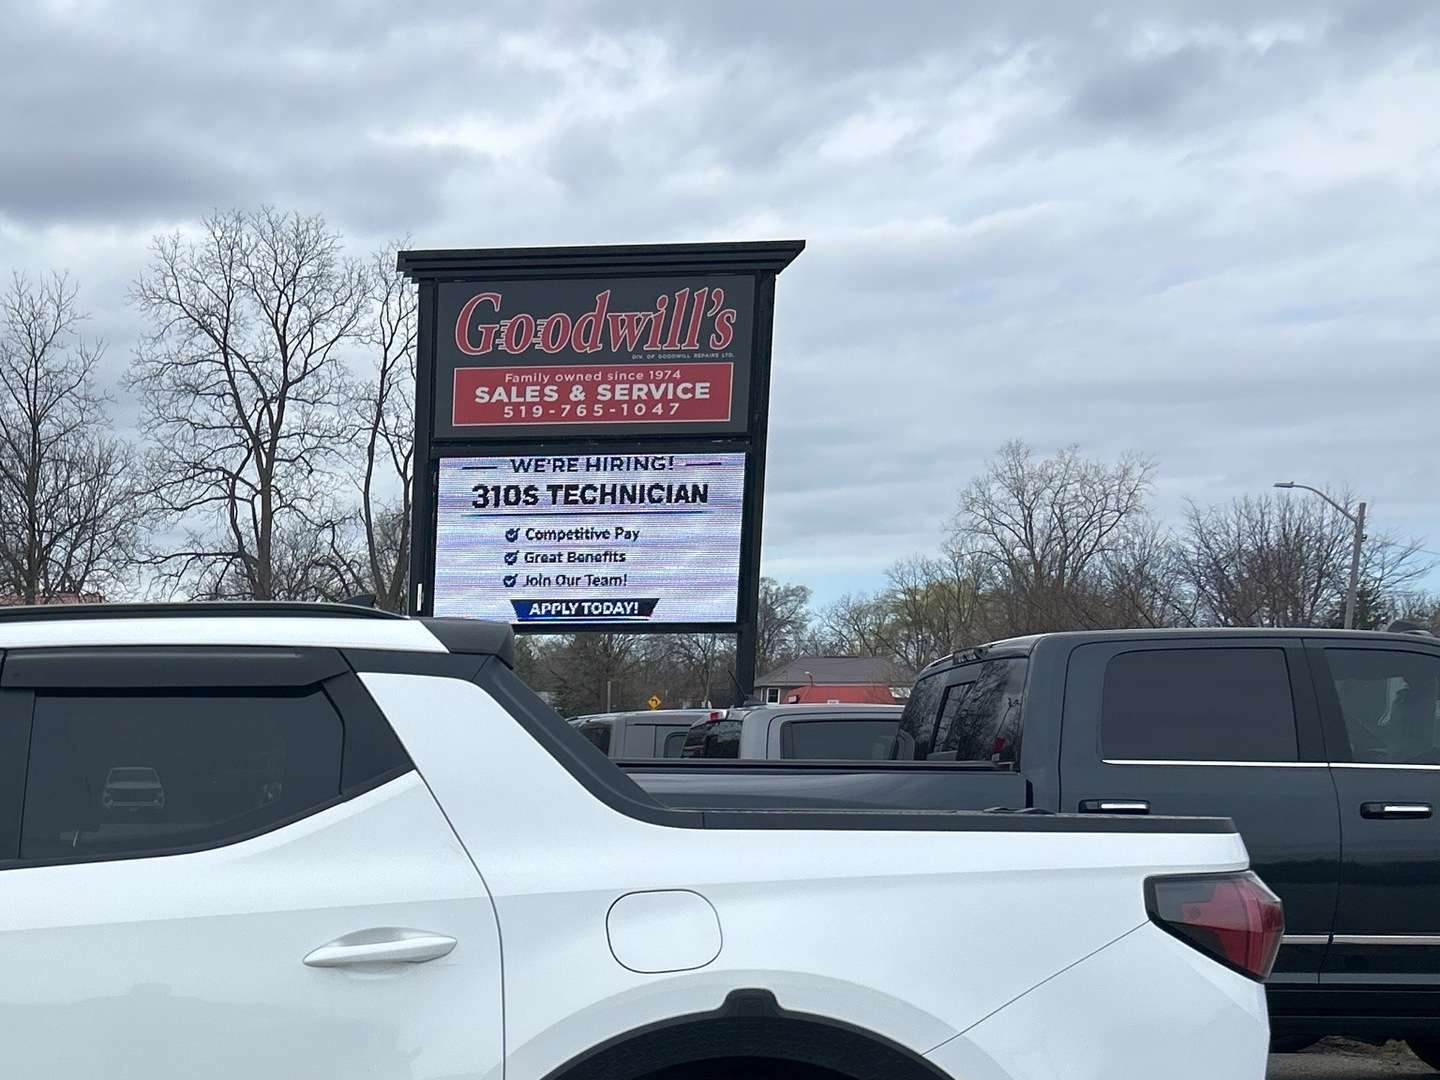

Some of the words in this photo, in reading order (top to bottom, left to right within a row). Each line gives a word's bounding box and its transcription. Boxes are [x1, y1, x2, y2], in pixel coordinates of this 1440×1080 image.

[455, 287, 737, 355] Goodwill's
[505, 373, 550, 384] Family
[555, 371, 602, 381] owned
[607, 371, 644, 381] since
[648, 370, 681, 380] 1974
[474, 386, 559, 403] SALES
[569, 384, 587, 401] &
[597, 382, 711, 401] SERVICE
[503, 403, 681, 418] 519-765-1047
[510, 457, 578, 473] WE'RE
[585, 456, 675, 472] HIRING!
[472, 484, 539, 508] 310S
[546, 483, 709, 505] TECHNICIAN
[525, 527, 611, 542] Competitive
[614, 527, 640, 541] Pay
[524, 552, 563, 564] Great
[567, 551, 626, 563] Benefits
[524, 574, 551, 587] Join
[555, 575, 581, 586] Our
[585, 574, 628, 586] Team!
[529, 603, 578, 616] APPLY
[581, 602, 638, 614] TODAY!
